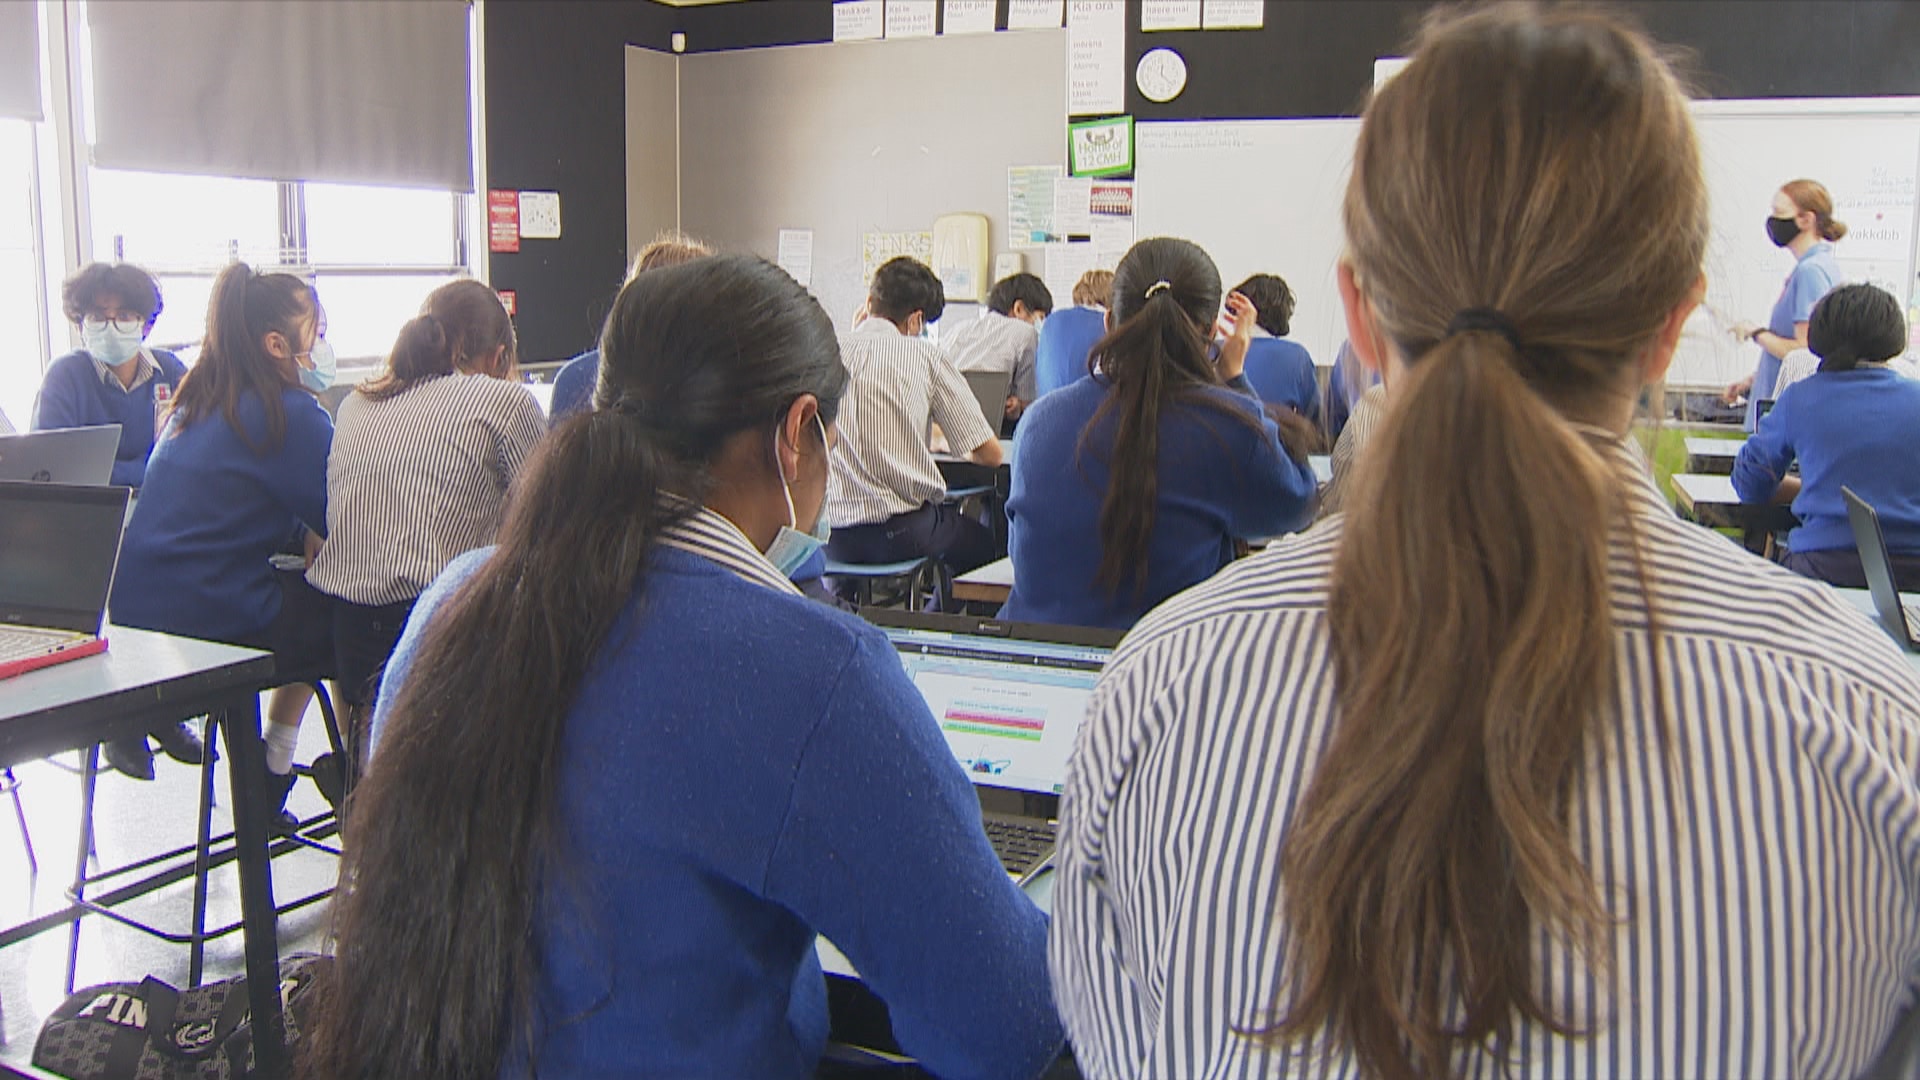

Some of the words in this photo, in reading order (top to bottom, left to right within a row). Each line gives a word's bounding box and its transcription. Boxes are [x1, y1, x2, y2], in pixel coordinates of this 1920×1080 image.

[1073, 1, 1091, 12] Kia
[1095, 1, 1113, 11] ora
[1079, 141, 1111, 154] Home
[1112, 138, 1122, 150] of
[1083, 155, 1094, 168] 12
[1096, 151, 1121, 165] CMH
[865, 233, 932, 255] SINKS
[79, 993, 149, 1029] PIN
